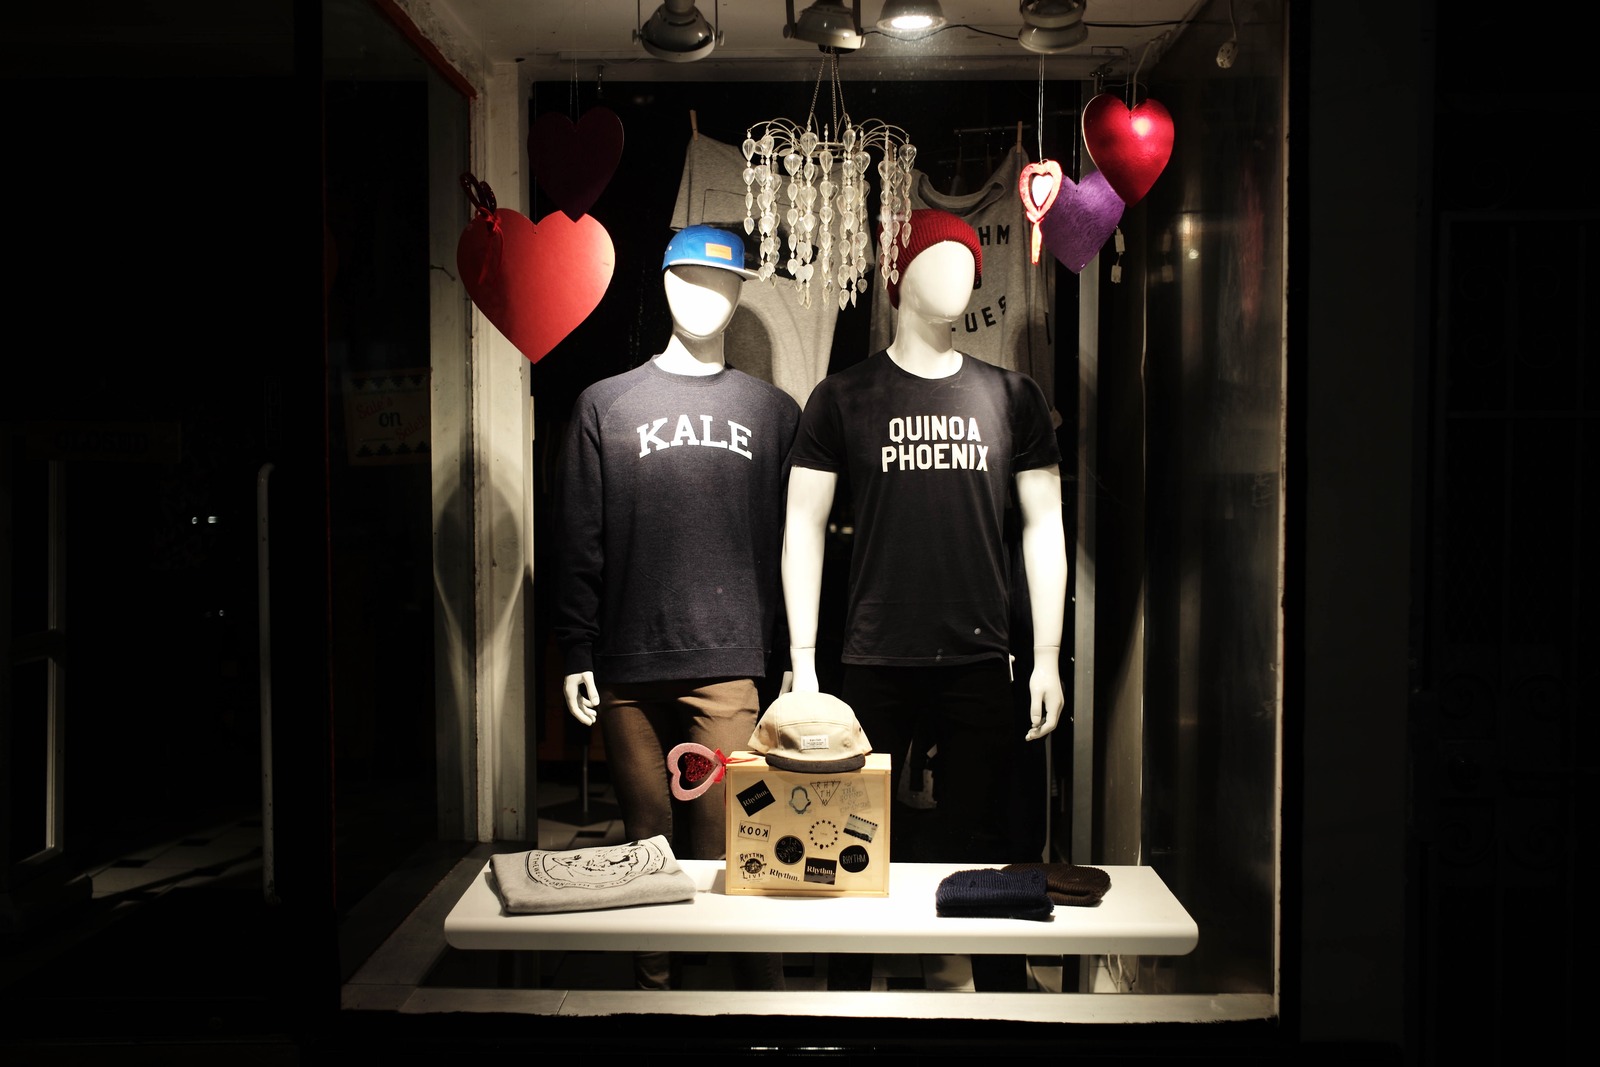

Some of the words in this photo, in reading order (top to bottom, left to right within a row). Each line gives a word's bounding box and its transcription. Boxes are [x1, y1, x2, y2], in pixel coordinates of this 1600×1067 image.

[379, 411, 402, 427] on
[889, 415, 982, 444] QUINOA
[636, 414, 753, 460] KALE
[881, 443, 989, 472] PHOENIX
[740, 825, 769, 838] KOOK
[739, 852, 765, 862] RHYTHM
[842, 854, 867, 865] RHYTHM
[769, 868, 800, 882] Rhythm.
[807, 865, 835, 876] Rhythm.
